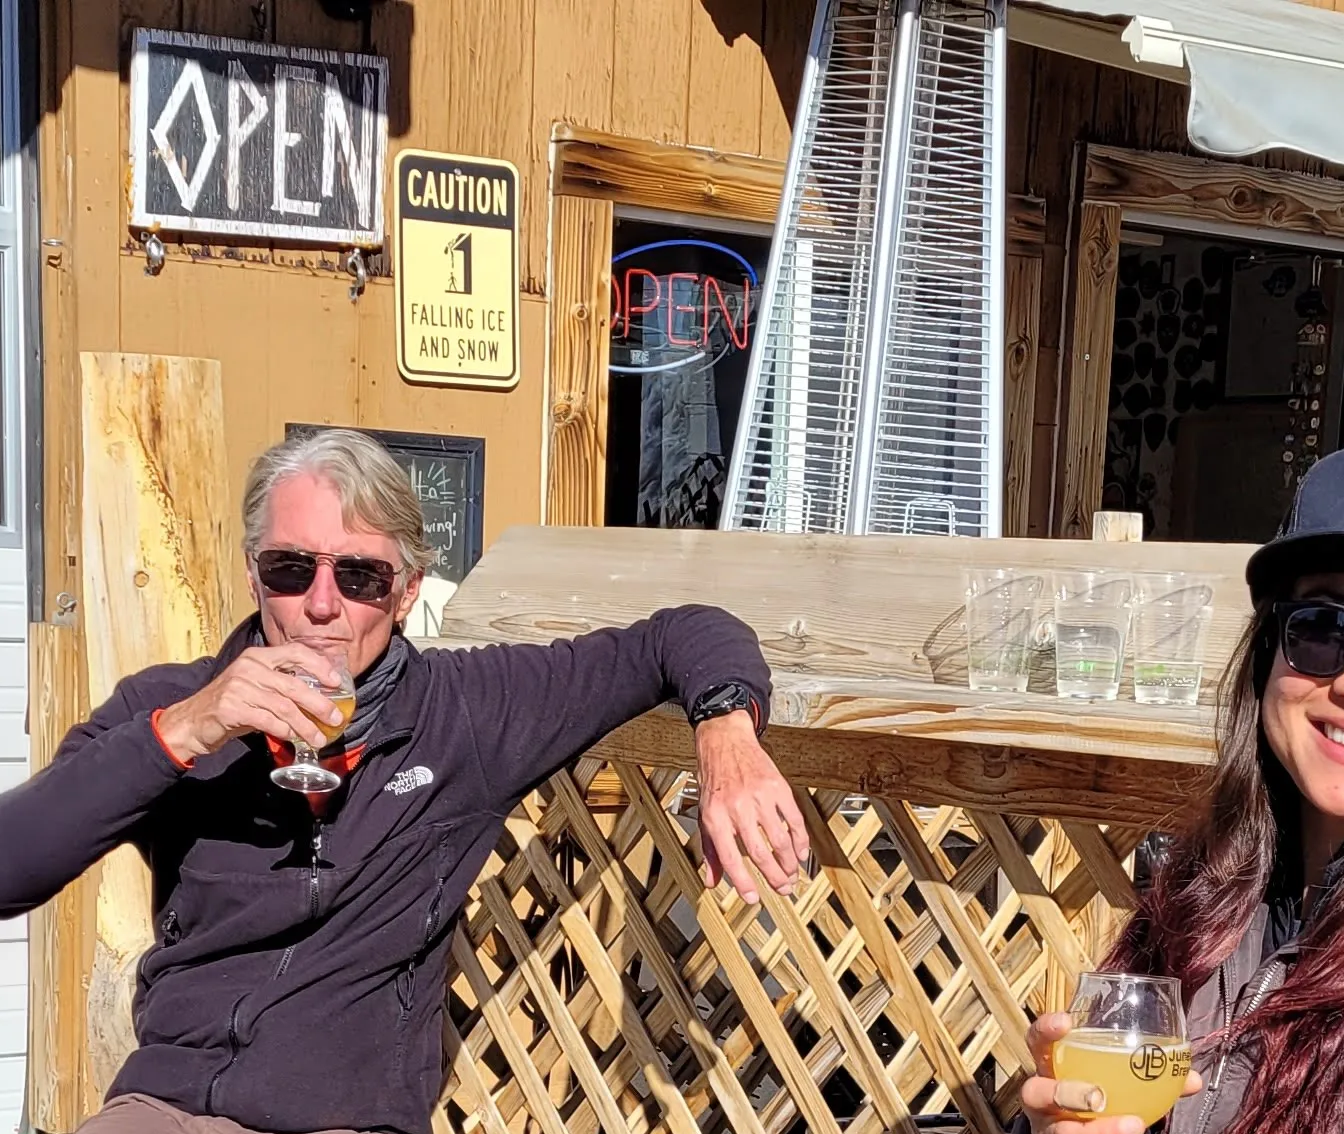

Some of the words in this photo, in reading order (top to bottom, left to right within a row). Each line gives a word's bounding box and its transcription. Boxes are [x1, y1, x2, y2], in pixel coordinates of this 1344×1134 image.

[150, 58, 376, 230] OPEN
[407, 168, 507, 217] CAUTION
[411, 303, 474, 329] FALLING
[482, 309, 505, 332] ICE
[419, 335, 450, 358] AND
[457, 338, 499, 362] SNOW
[423, 512, 457, 551] wing!
[384, 774, 416, 791] NORTH
[394, 768, 415, 781] THE
[394, 782, 416, 796] FACE
